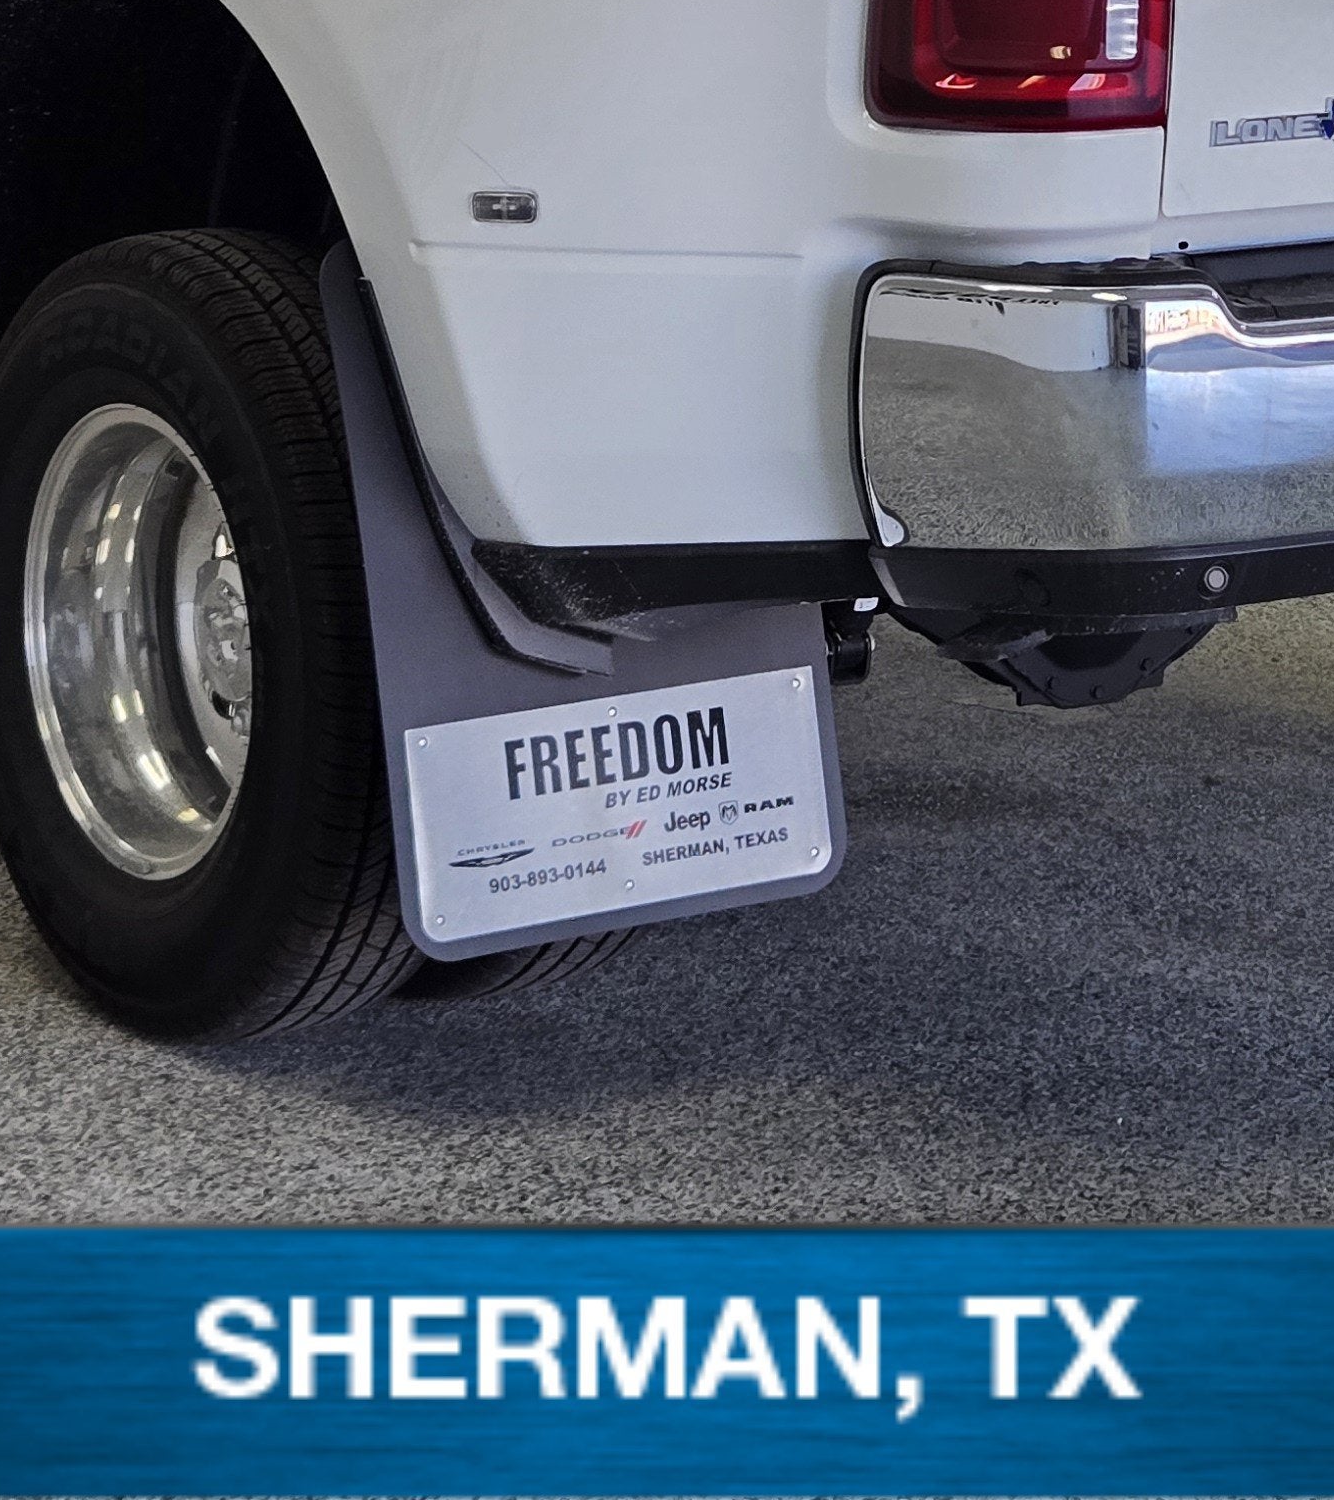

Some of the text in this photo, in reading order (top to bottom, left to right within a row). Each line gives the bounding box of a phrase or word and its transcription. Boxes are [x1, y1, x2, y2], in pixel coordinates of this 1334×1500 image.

[1209, 113, 1324, 147] LONE
[504, 706, 730, 800] FREEDOM
[605, 772, 733, 809] BY ED MORSE
[663, 810, 711, 832] Jeep
[743, 796, 794, 813] RAM
[489, 827, 789, 894] 903-893-0144 SHERMAN, TEXAS
